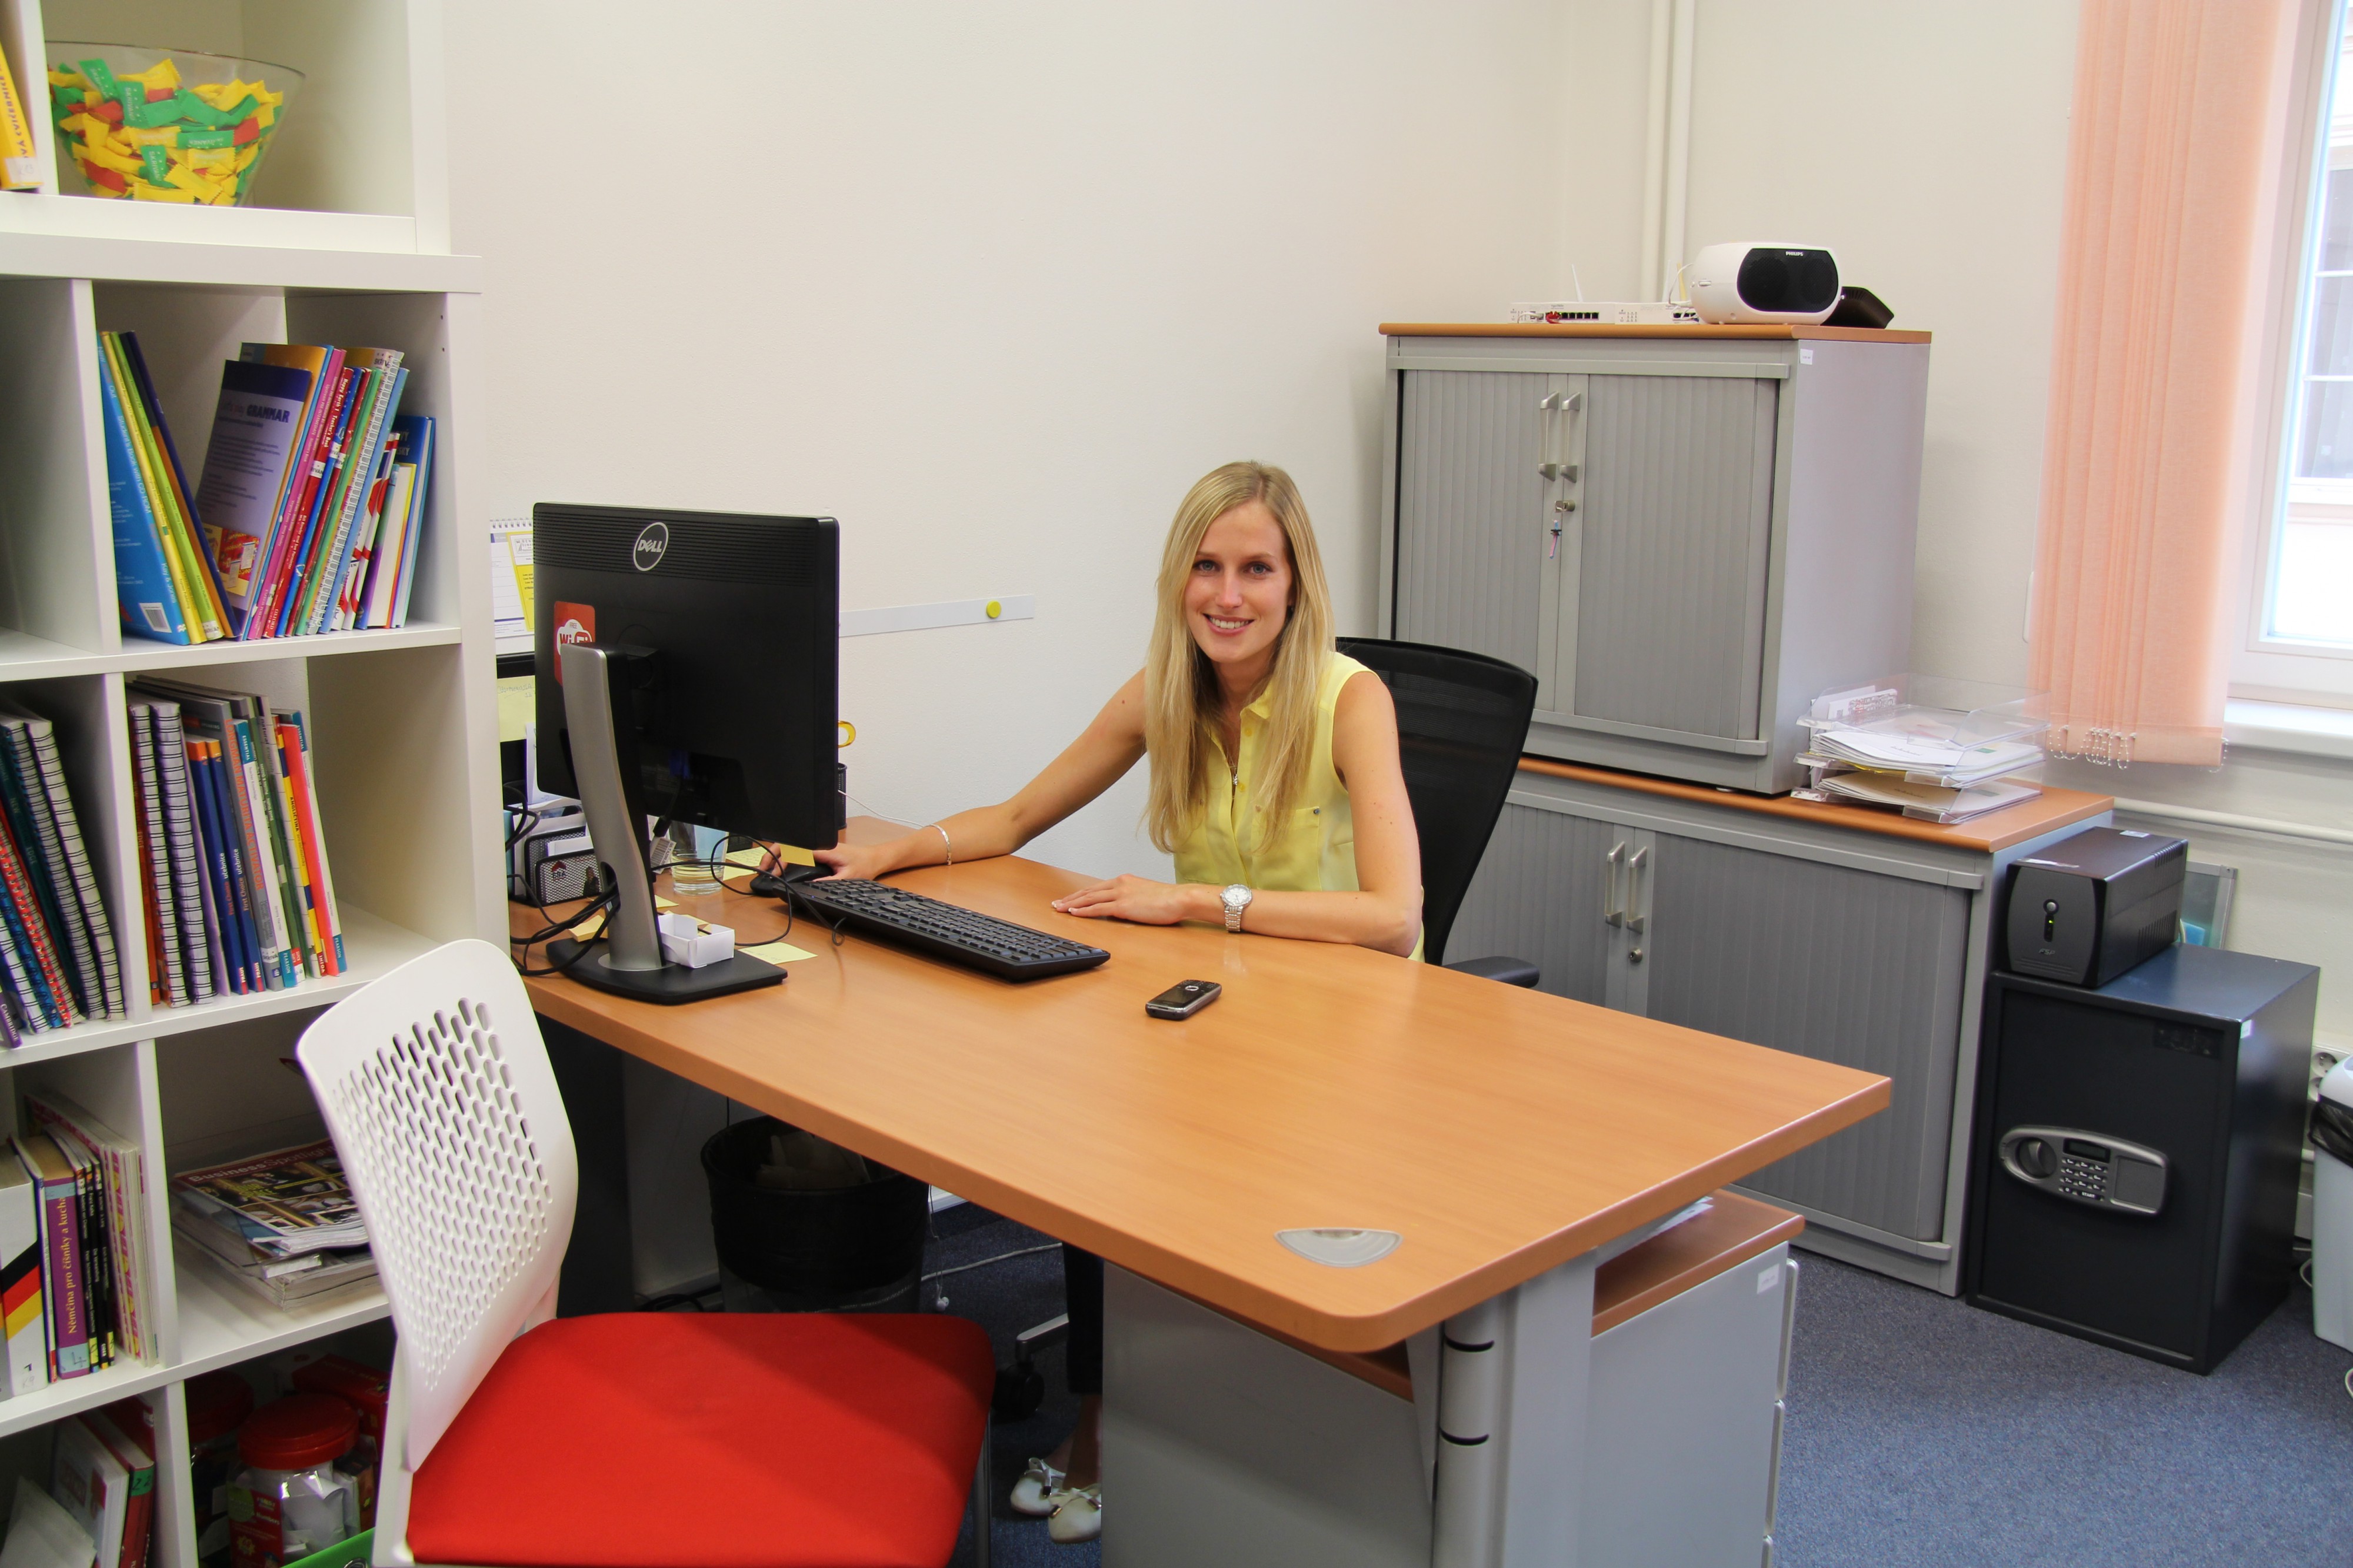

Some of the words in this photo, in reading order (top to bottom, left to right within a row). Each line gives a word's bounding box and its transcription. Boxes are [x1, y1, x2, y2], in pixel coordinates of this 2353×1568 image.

[339, 378, 348, 393] Happy
[335, 393, 344, 408] Earth
[247, 405, 290, 423] GRAMMAR
[108, 385, 116, 398] Out
[117, 415, 131, 446] Student's
[127, 447, 137, 465] Book
[132, 467, 141, 482] with
[327, 415, 338, 436] Teacher's
[638, 539, 662, 552] DELL
[159, 562, 169, 576] Kay
[166, 583, 177, 603] Jones
[269, 608, 279, 630] OXFORD
[259, 719, 271, 745] natural
[295, 725, 306, 749] ESSENTIAL
[241, 735, 252, 760] ESSENTIAL
[222, 718, 243, 773] LONGMAN
[234, 775, 254, 829] MATURITA
[244, 830, 265, 890] ACTIVATOR
[25, 846, 37, 865] EDGE
[217, 852, 229, 879] učebnice
[232, 848, 242, 875] učebnice
[222, 880, 232, 902] Choice
[237, 877, 246, 897] Choice
[226, 902, 235, 915] First
[334, 938, 342, 958] PEARSON
[252, 962, 261, 978] FRAUS
[282, 952, 291, 973] PEARSON
[237, 966, 246, 983] FRAUS
[0, 1003, 20, 1041] CAMBRIDGE
[188, 1163, 267, 1181] Business
[56, 1197, 67, 1225] kucha
[60, 1237, 72, 1269] číšníky
[64, 1272, 74, 1288] pro
[64, 1291, 76, 1333] Němčina
